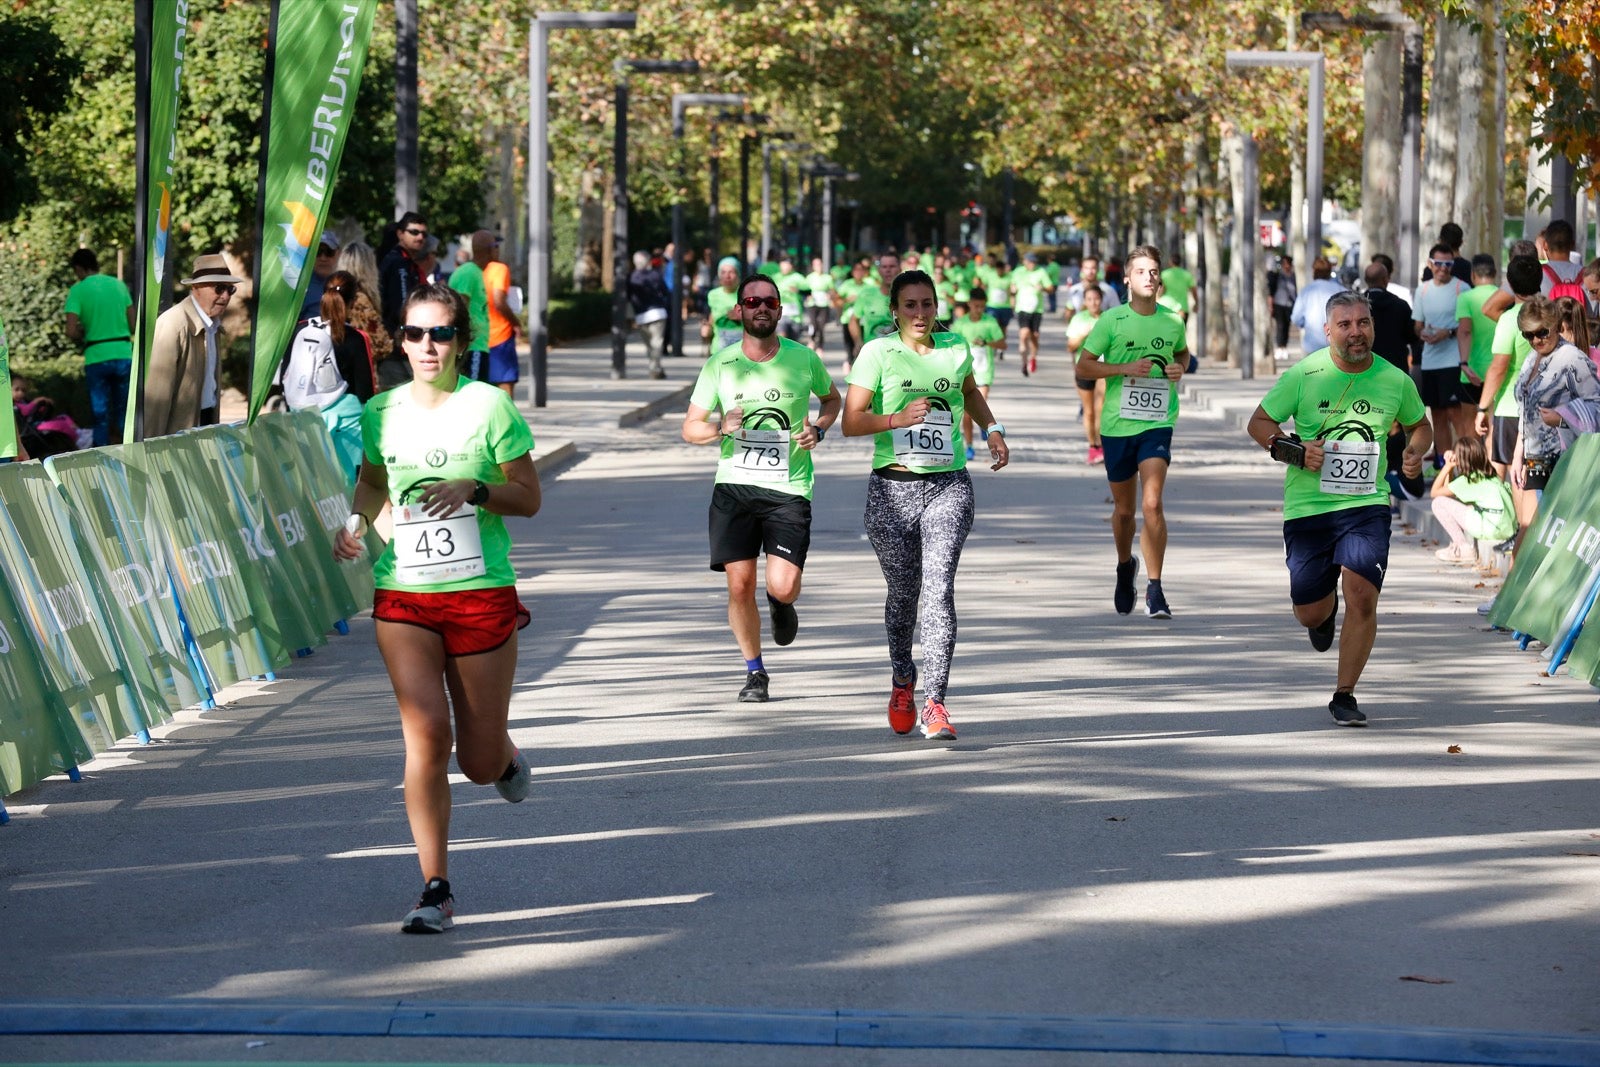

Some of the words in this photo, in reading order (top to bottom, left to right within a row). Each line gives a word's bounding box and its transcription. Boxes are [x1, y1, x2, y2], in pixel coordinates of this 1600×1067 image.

[1128, 390, 1163, 409] 595
[904, 428, 944, 451] 156
[741, 445, 781, 467] 773
[1330, 458, 1370, 480] 328
[415, 527, 455, 559] 43
